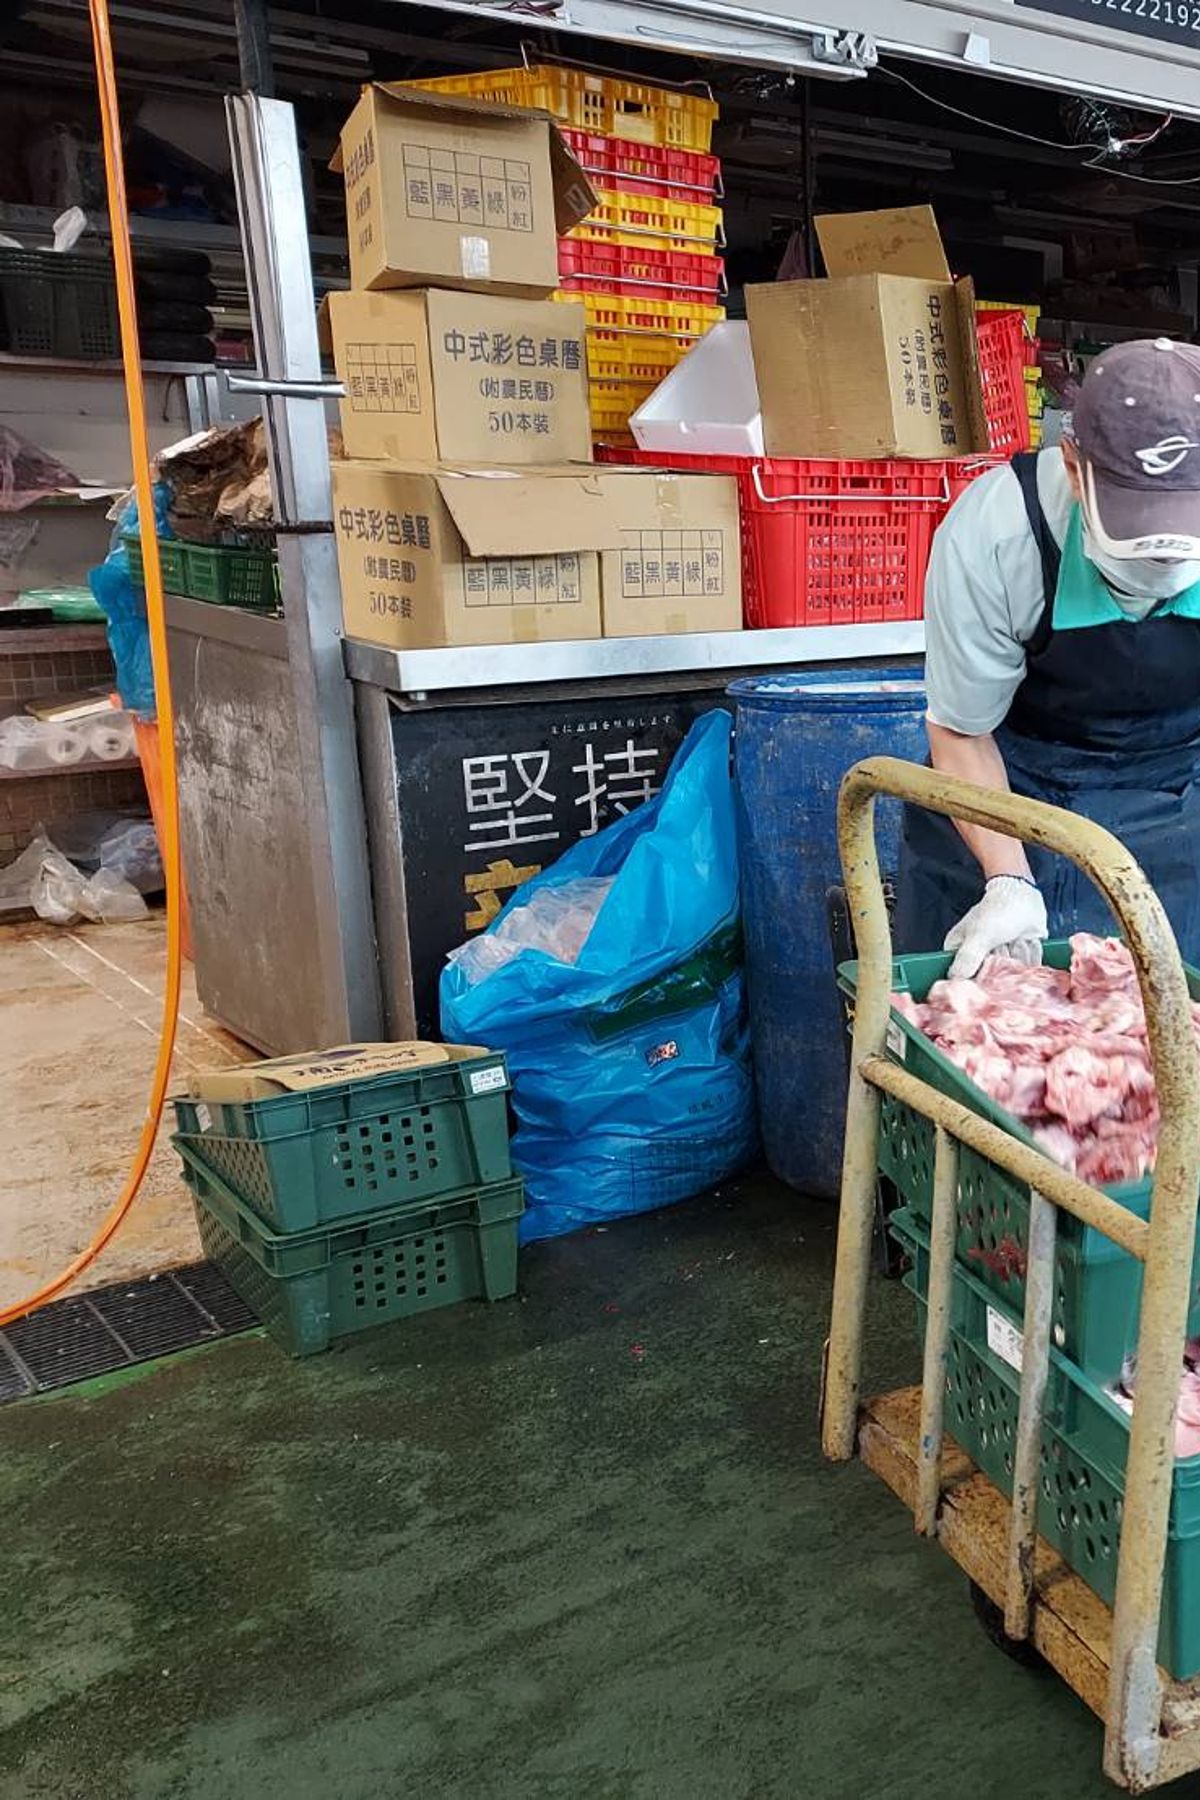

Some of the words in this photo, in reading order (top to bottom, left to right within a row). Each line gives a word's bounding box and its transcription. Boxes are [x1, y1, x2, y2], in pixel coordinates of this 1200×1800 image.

[443, 329, 581, 370] 中式彩色桌曆
[488, 411, 550, 434] 50本裝
[339, 506, 431, 549] 中式彩色桌曆
